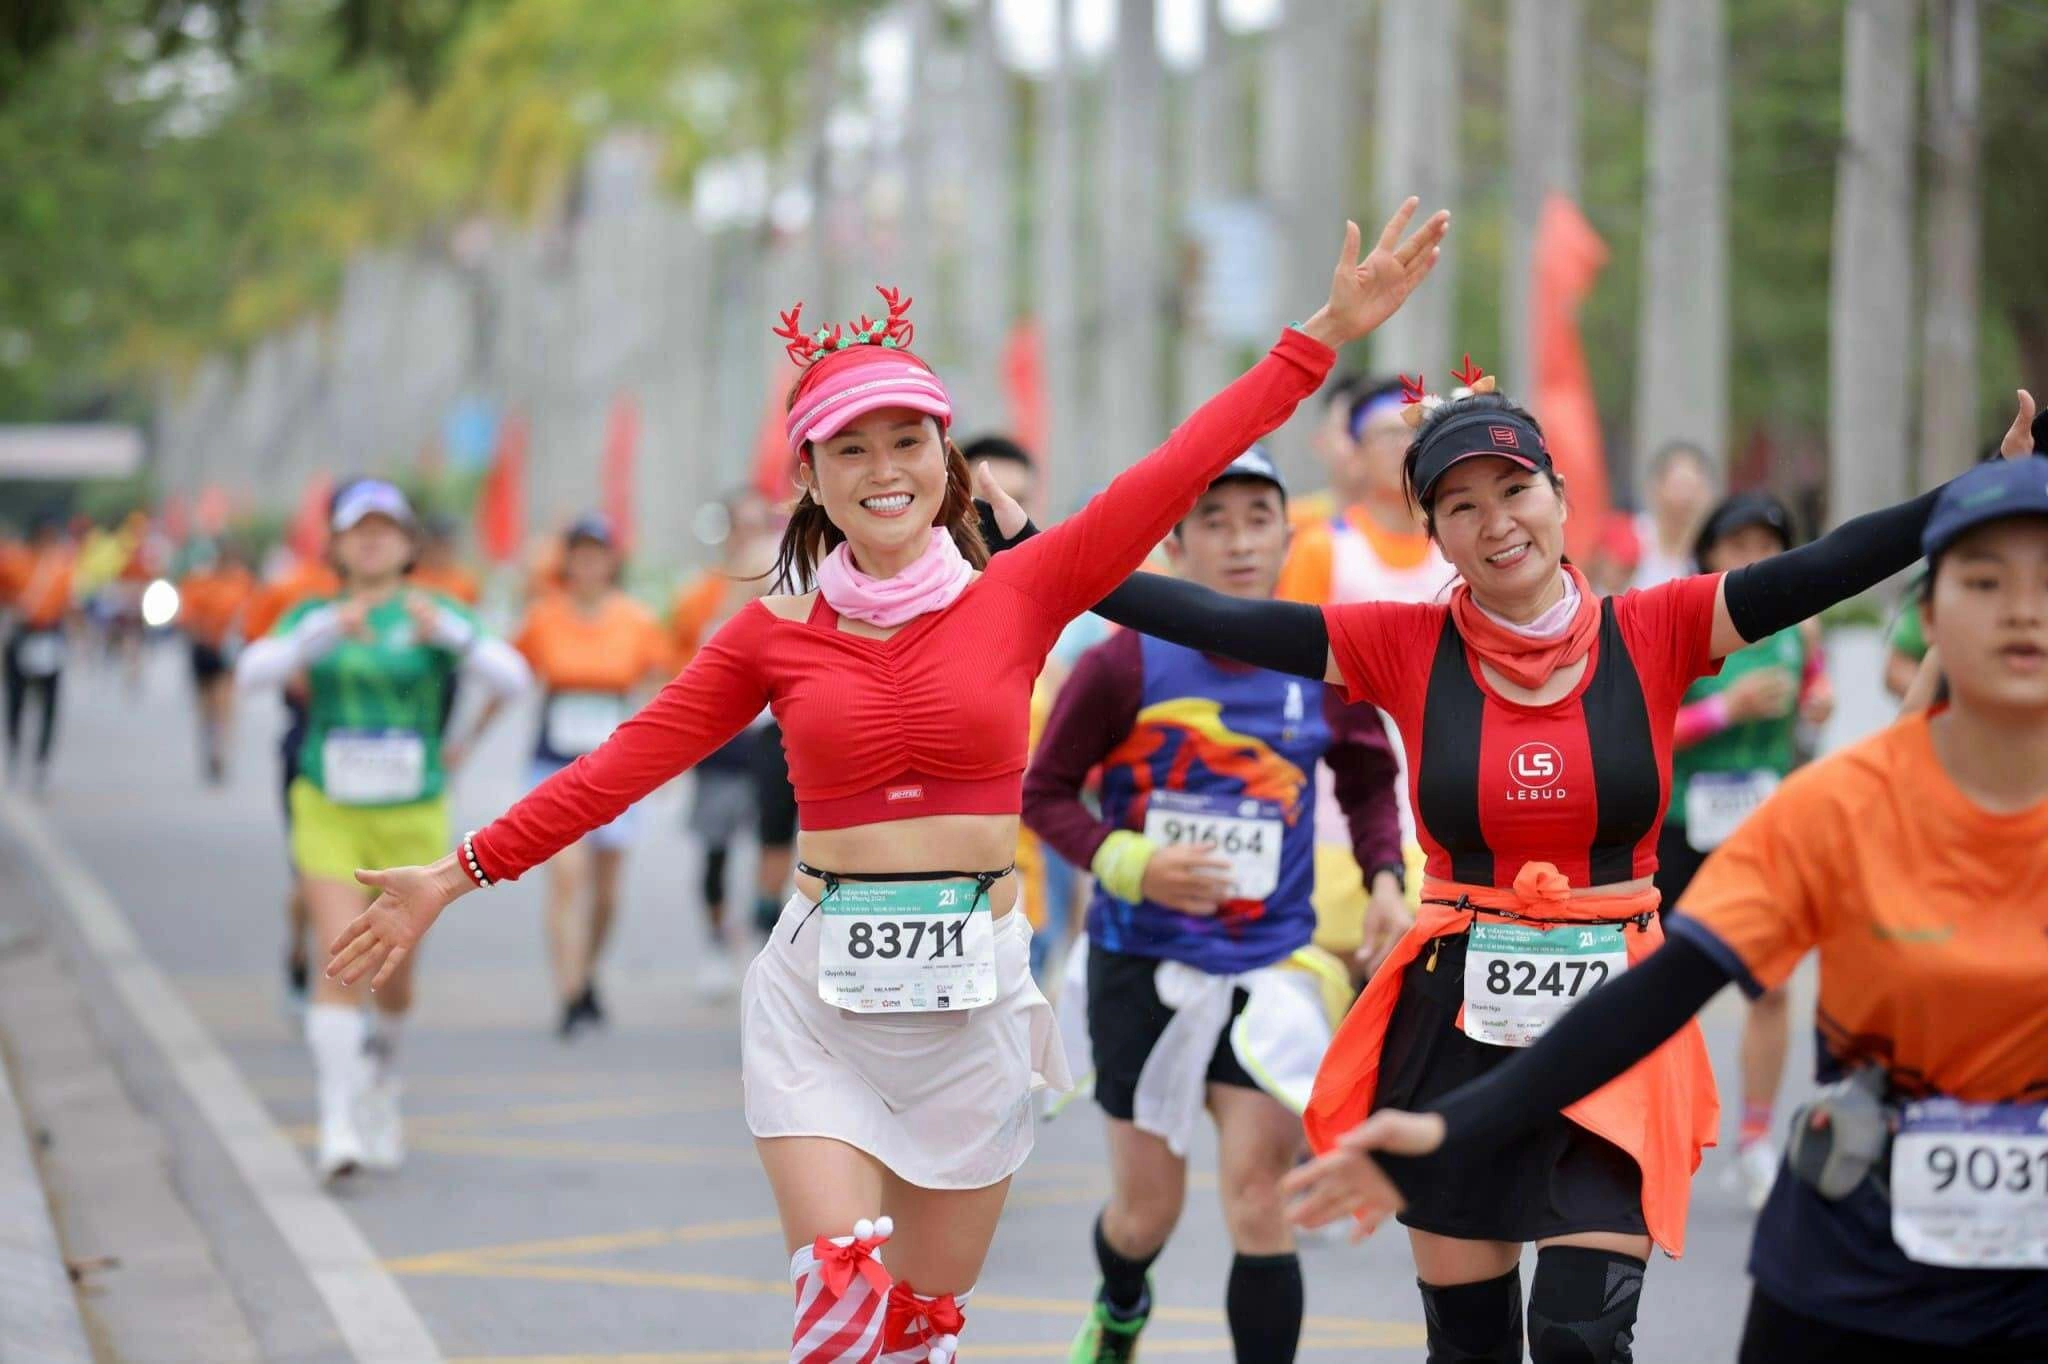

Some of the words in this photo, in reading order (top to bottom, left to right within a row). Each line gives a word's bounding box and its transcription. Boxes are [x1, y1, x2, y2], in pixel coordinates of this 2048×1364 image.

[1518, 753, 1553, 776] LS
[1506, 789, 1566, 800] LESUD
[1164, 820, 1264, 855] 91664
[848, 920, 964, 960] 83711
[1486, 959, 1609, 997] 82472
